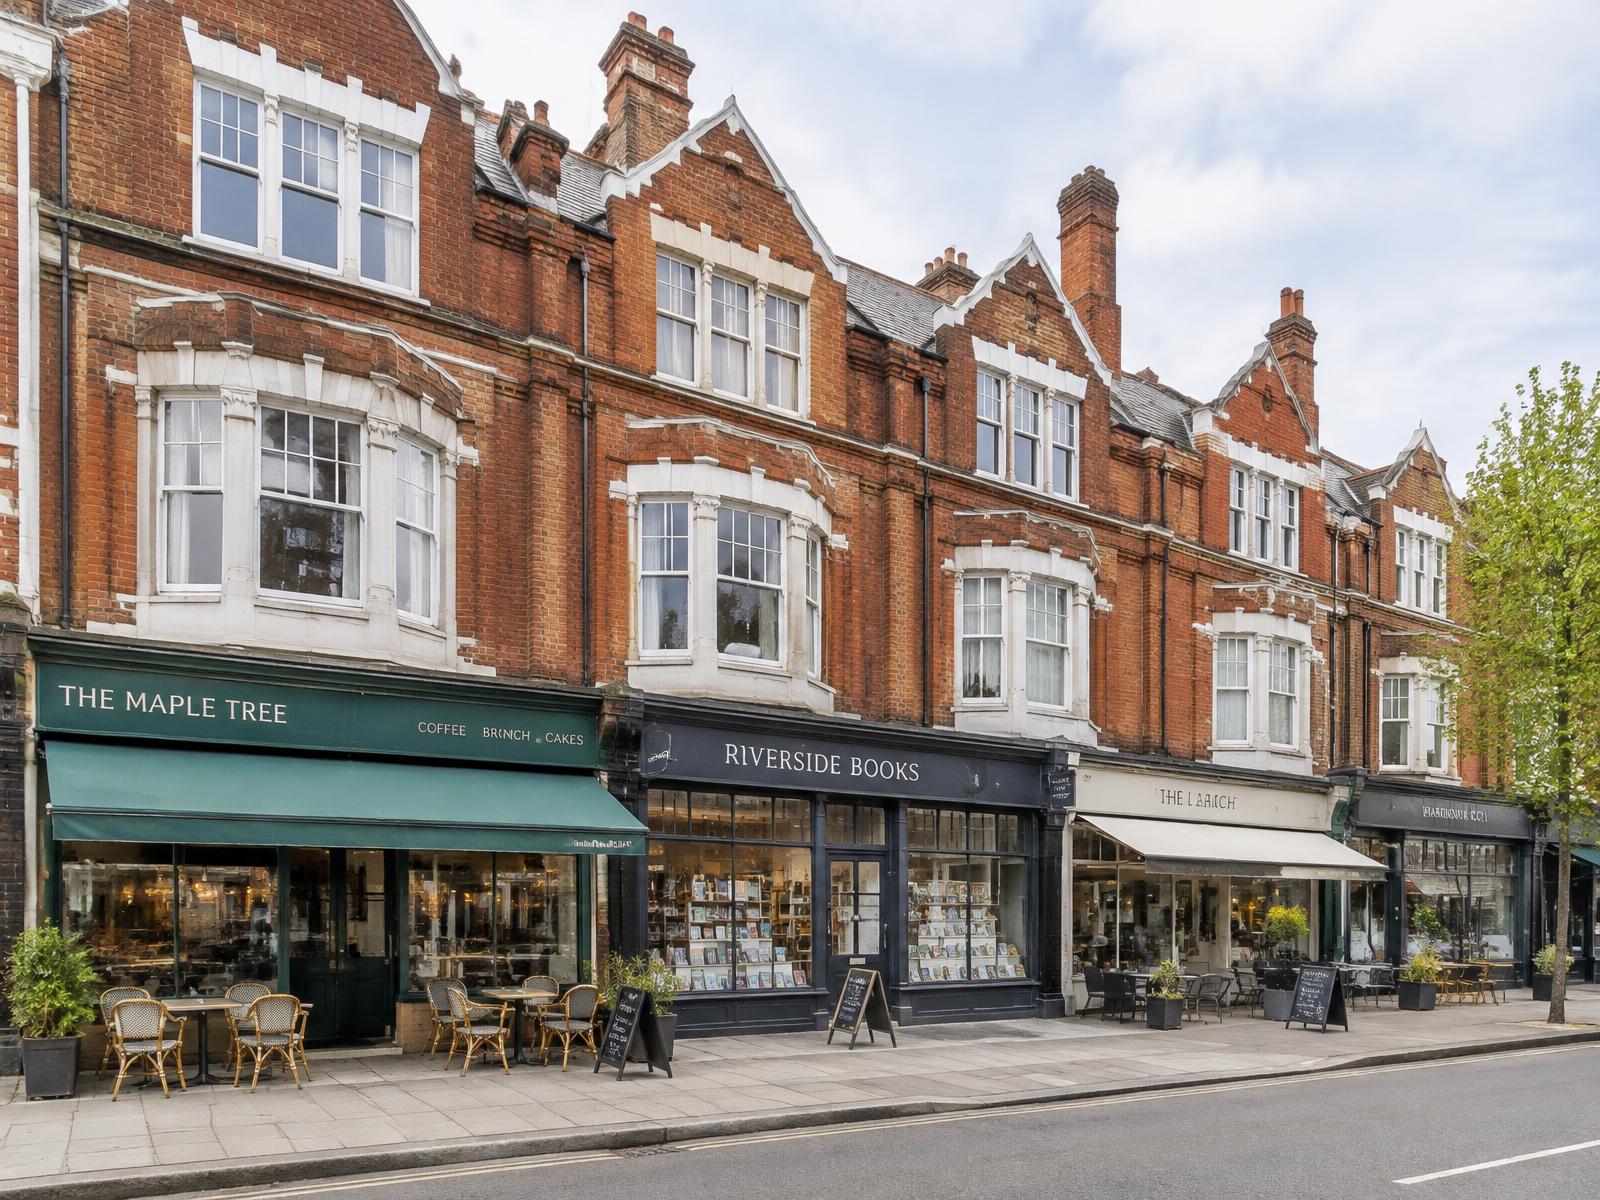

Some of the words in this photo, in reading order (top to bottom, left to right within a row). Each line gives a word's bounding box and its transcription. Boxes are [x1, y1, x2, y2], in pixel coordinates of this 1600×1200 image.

[58, 684, 114, 710] THE
[126, 690, 216, 718] MAPLE
[225, 699, 287, 724] TREE
[418, 721, 467, 736] COFFEE
[545, 732, 584, 745] CAKES
[724, 743, 841, 775] RIVERSIDE
[850, 756, 919, 782] BOOKS
[1160, 789, 1183, 806] THE
